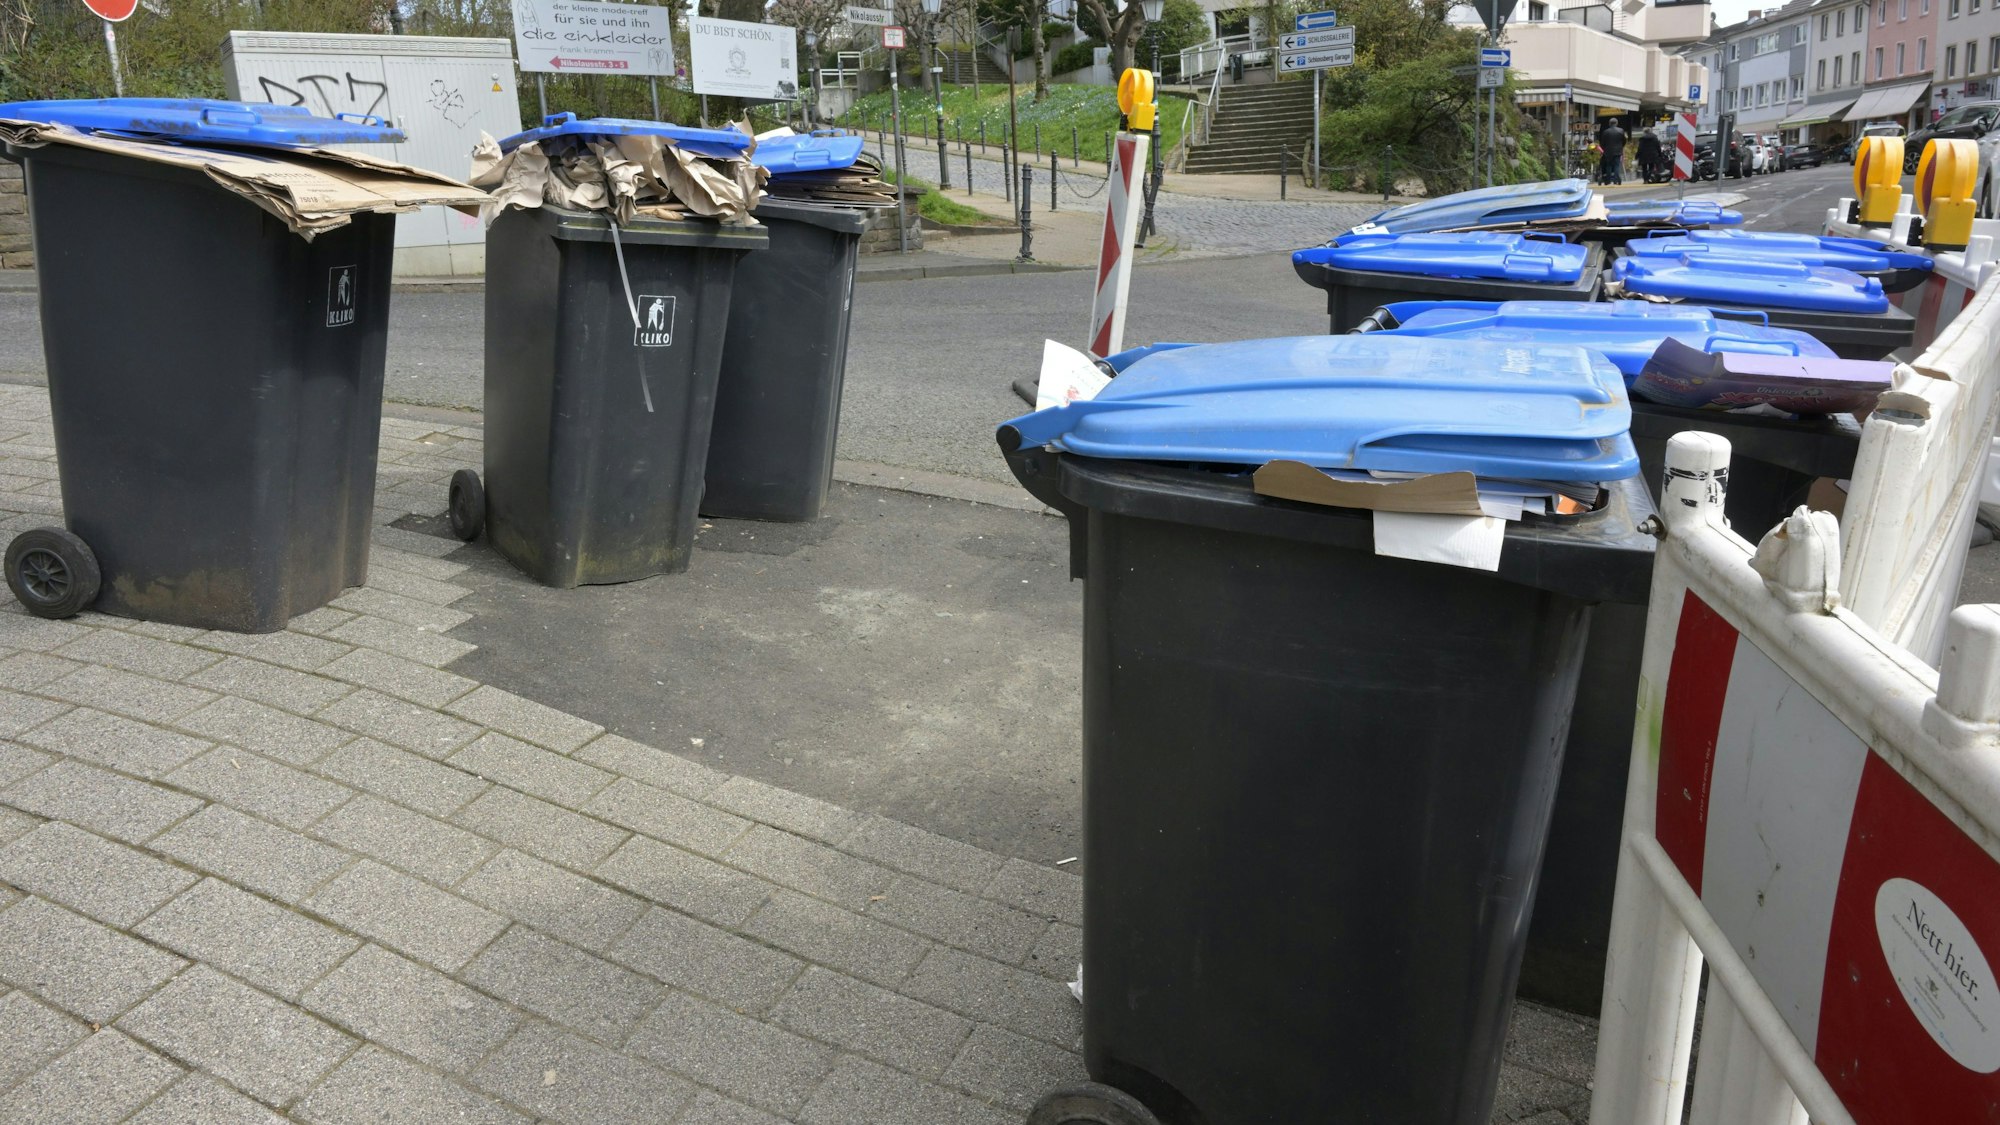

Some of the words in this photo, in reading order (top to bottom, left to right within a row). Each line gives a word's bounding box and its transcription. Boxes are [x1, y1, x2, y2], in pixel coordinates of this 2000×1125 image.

[571, 4, 599, 13] kleine
[601, 6, 649, 16] mode-treff
[850, 10, 887, 23] Nikolausstr.
[554, 14, 574, 24] für
[579, 15, 597, 26] sie
[602, 17, 626, 27] und
[631, 18, 650, 28] ihn
[522, 27, 557, 40] die
[564, 29, 666, 45] einkleider
[695, 24, 711, 35] DU
[713, 26, 736, 38] BIST
[737, 28, 775, 42] SCHÖN.
[559, 46, 581, 54] frank
[583, 47, 615, 55] kramm
[560, 58, 607, 68] Nikolausstr.
[1691, 86, 1699, 98] P
[329, 308, 354, 324] KLIKO
[1906, 898, 1944, 956] Nett
[1944, 942, 1979, 1002] hier.
